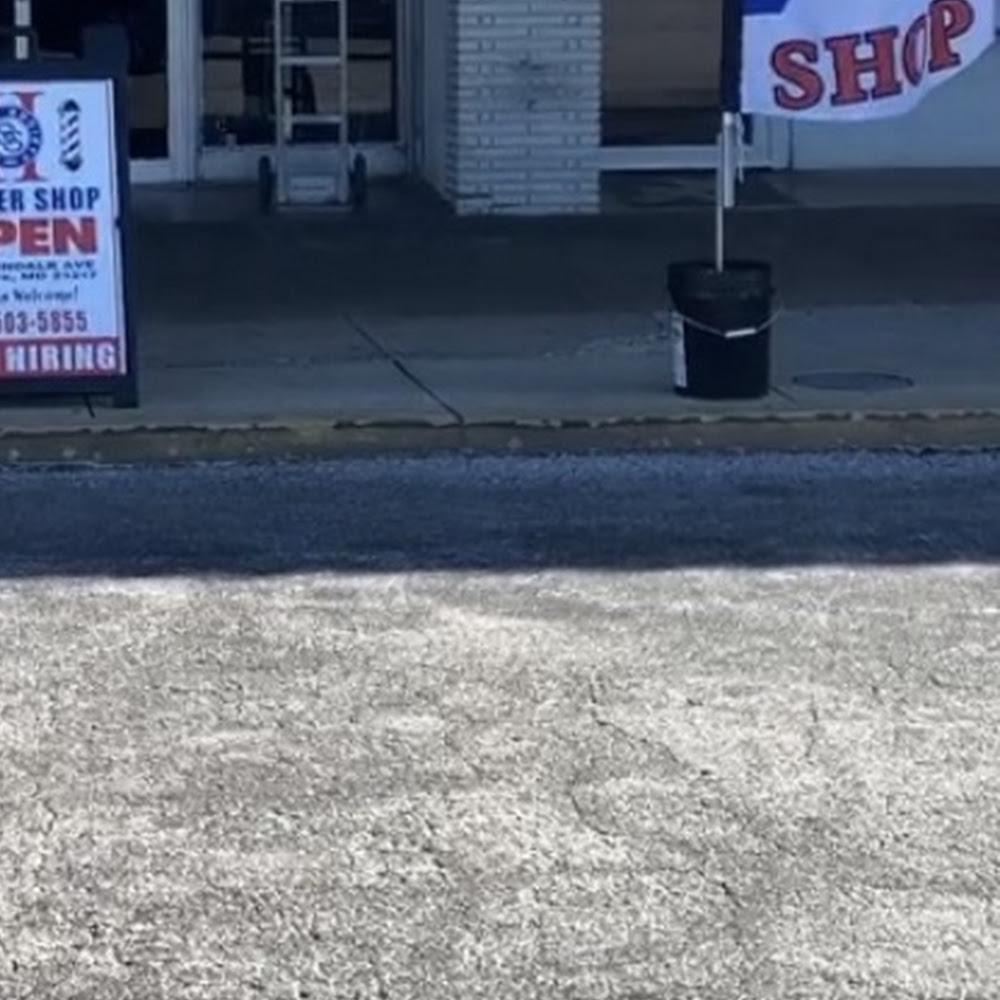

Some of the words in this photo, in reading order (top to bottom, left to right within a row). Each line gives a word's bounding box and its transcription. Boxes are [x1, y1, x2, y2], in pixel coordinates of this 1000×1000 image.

[35, 187, 100, 212] SHOP
[63, 259, 96, 270] AVE
[4, 343, 118, 373] HIRING
